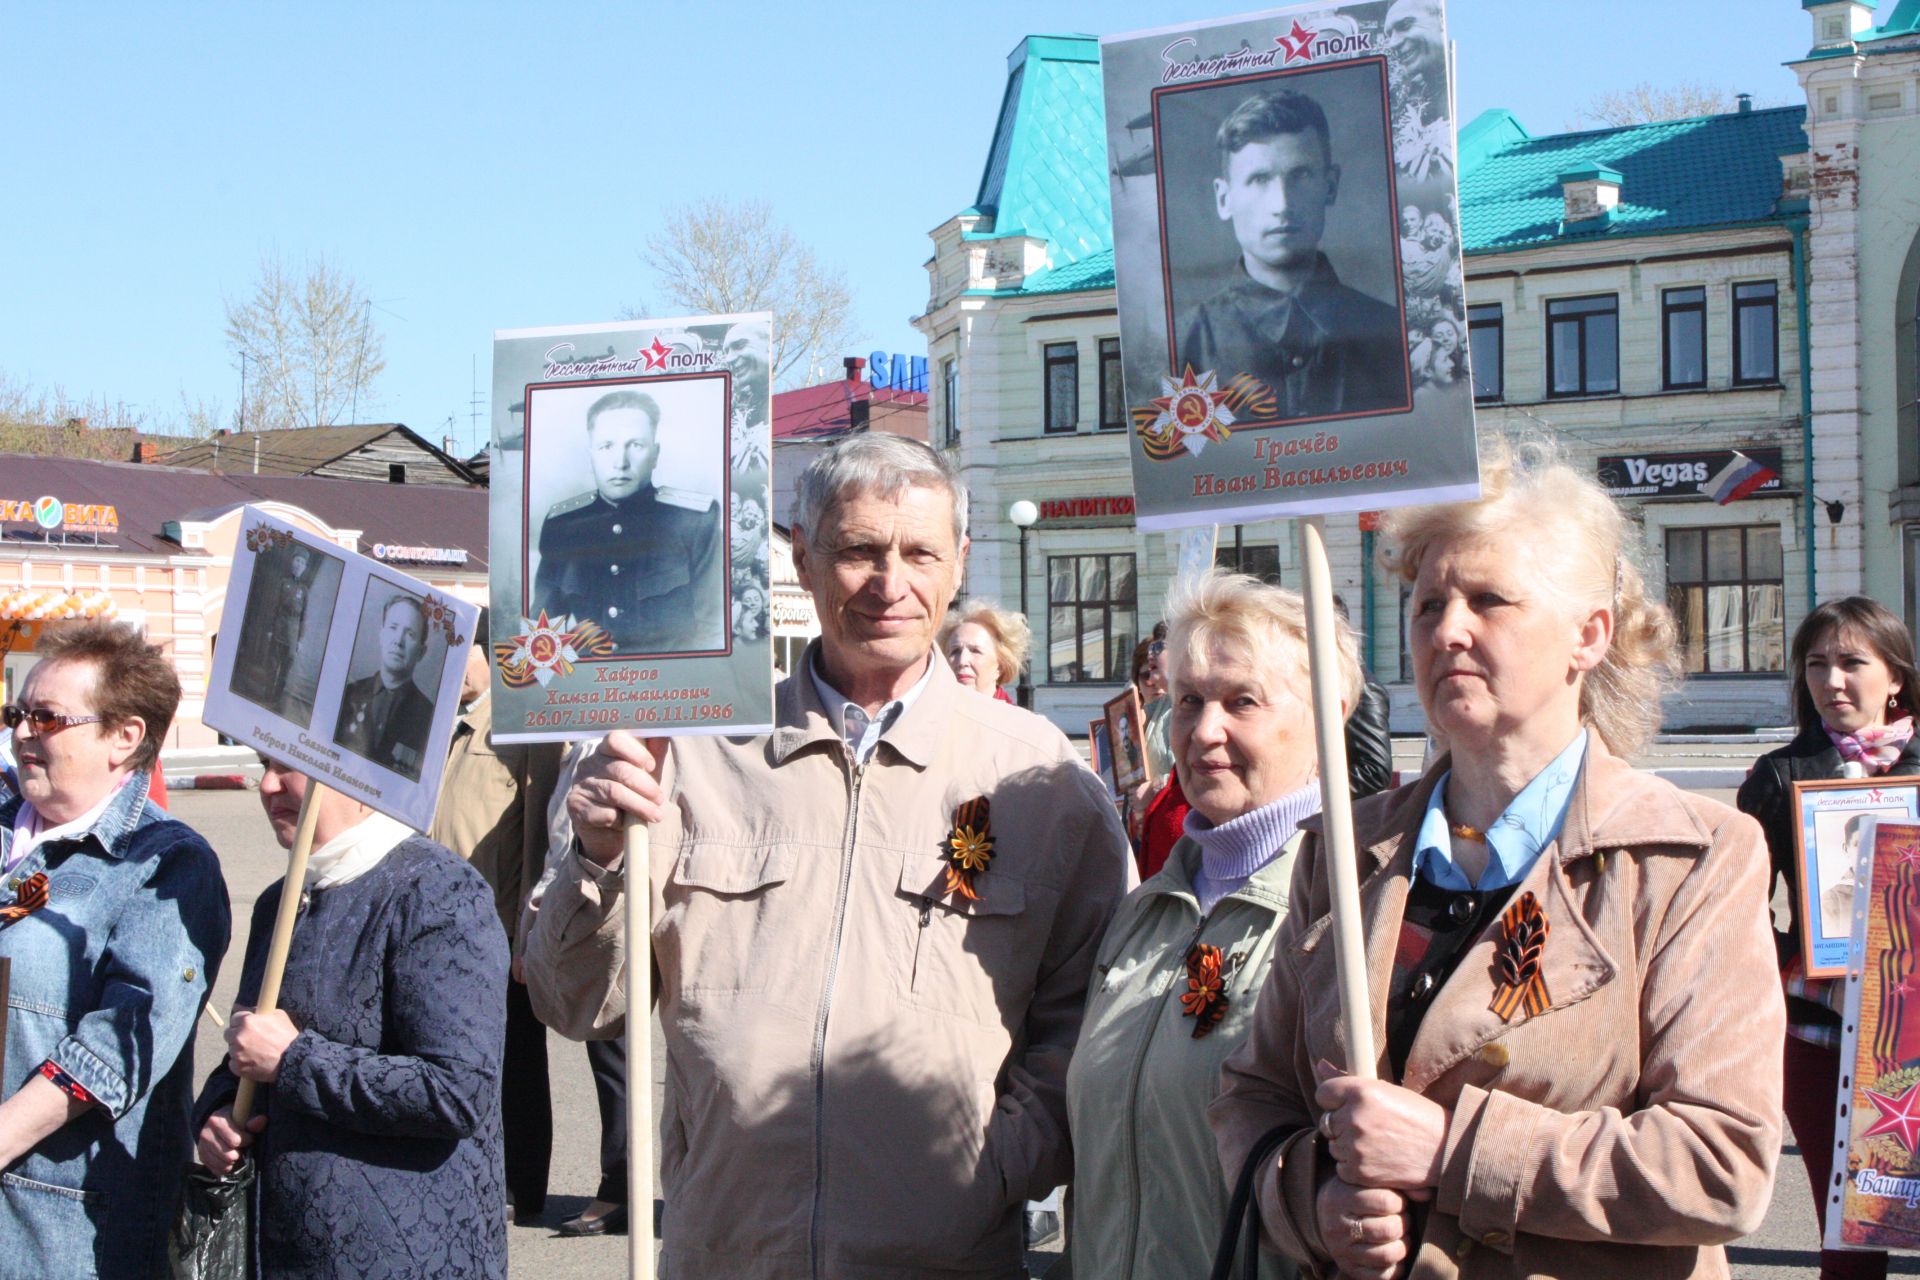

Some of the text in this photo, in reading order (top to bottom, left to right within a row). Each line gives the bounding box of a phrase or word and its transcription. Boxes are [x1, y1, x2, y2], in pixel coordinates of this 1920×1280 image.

[1254, 432, 1339, 465] Грачёв
[1193, 459, 1408, 496] Иван Васильевич
[1624, 458, 1709, 487] Vegas
[63, 504, 119, 526] ВИТА
[1041, 496, 1135, 519] НАПИТКИ
[594, 666, 659, 685] Хайров
[545, 686, 710, 705] Хамза Исмаилович
[526, 708, 620, 727] 26.07.1908
[634, 703, 733, 722] 06.11.1986
[287, 744, 331, 773] Николай
[332, 766, 383, 798] Иванович
